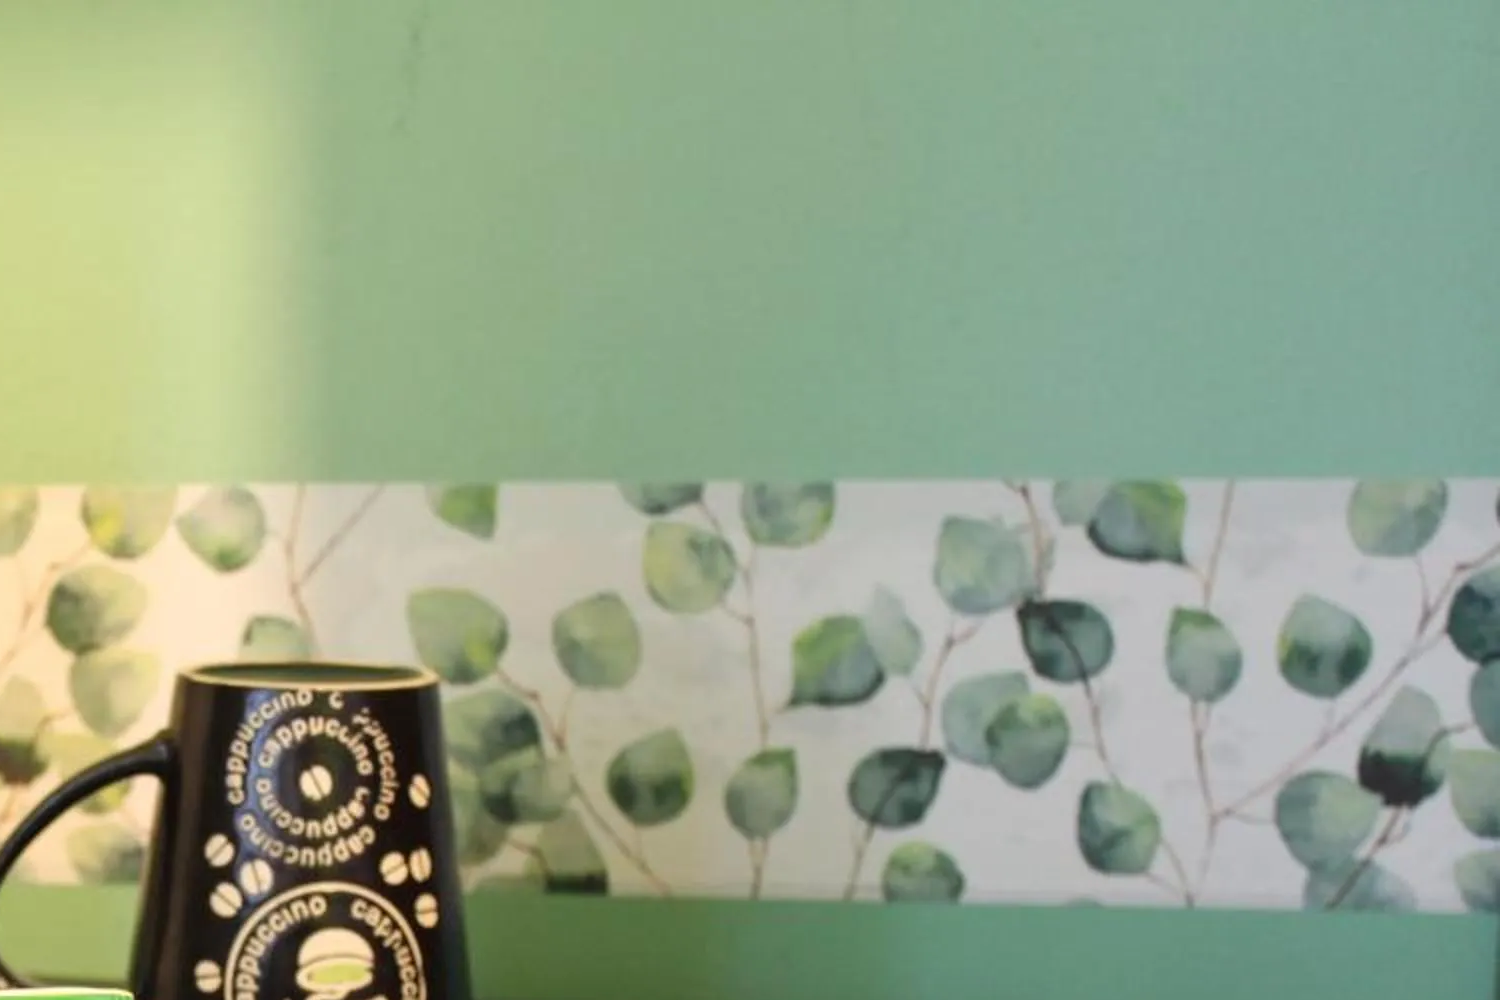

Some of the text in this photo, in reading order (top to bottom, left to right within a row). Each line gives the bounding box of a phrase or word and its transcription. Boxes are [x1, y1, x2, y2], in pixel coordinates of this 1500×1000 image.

[225, 689, 314, 805] cappuccino
[258, 715, 373, 776] cappuccino
[255, 777, 371, 839] cappuccino
[239, 813, 376, 867] cappuccino
